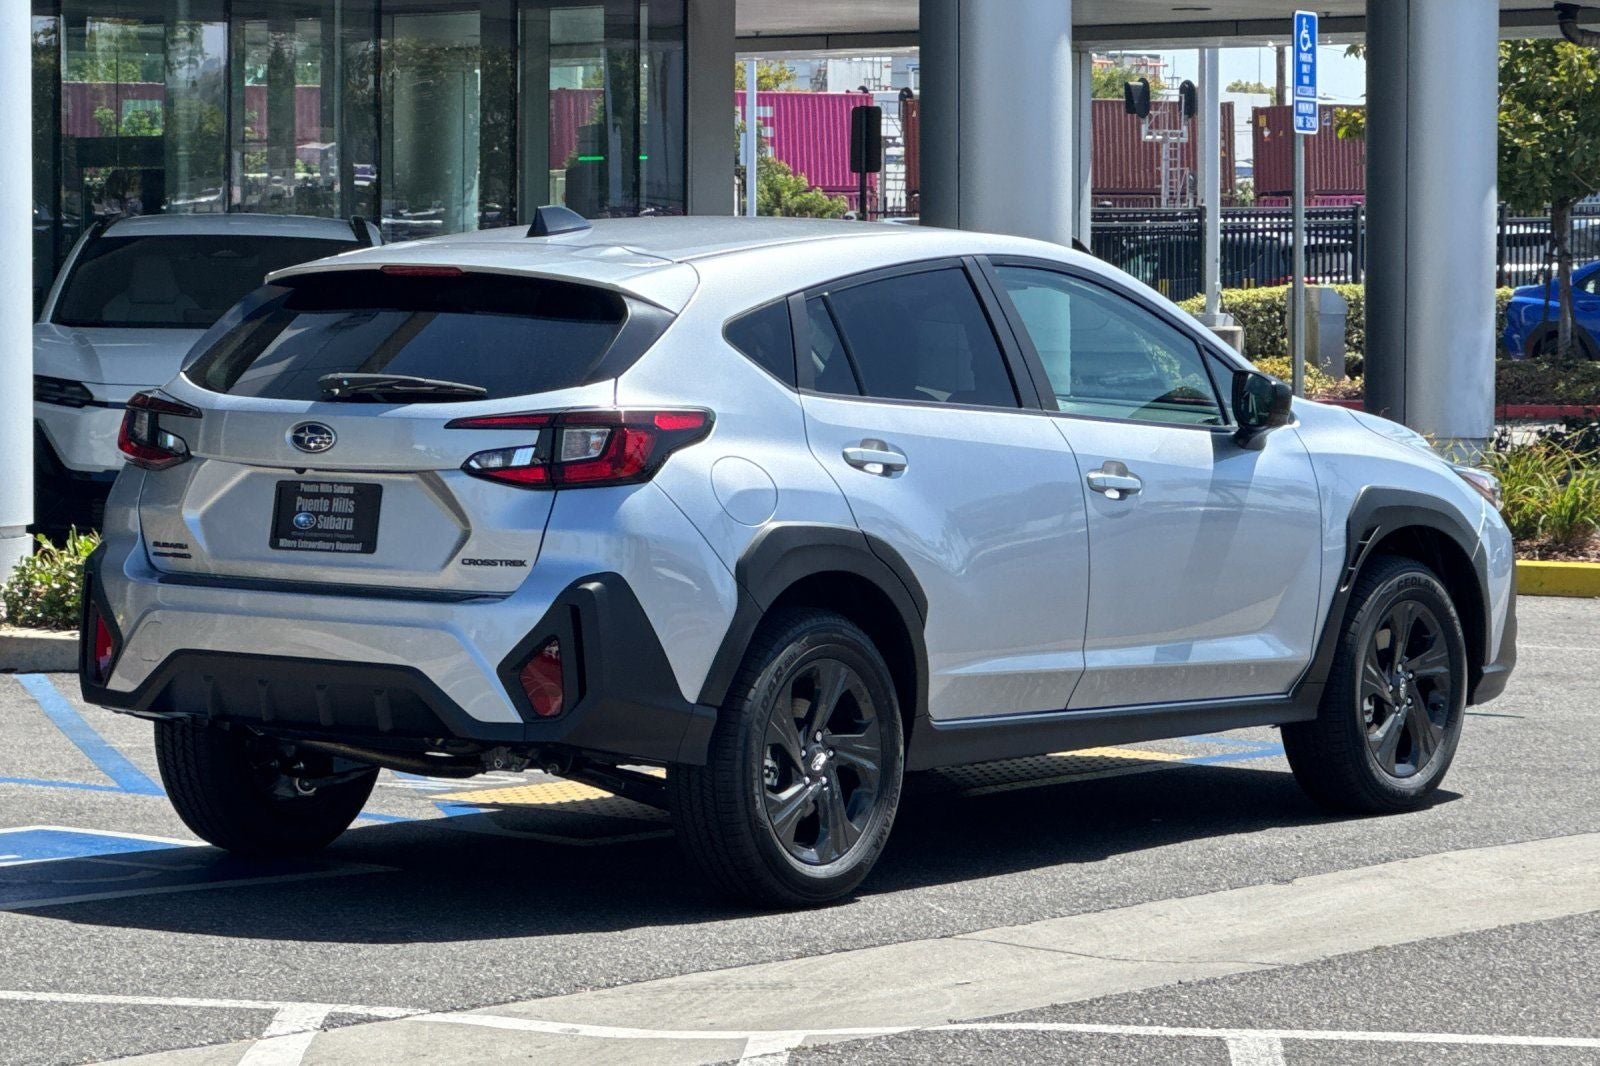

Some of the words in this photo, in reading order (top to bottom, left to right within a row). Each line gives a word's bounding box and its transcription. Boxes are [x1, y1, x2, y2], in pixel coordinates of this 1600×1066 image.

[333, 484, 354, 494] Subaru
[296, 496, 330, 512] Puente
[331, 497, 355, 513] Hills
[317, 514, 354, 531] Subaru
[461, 558, 527, 567] CROSSTREK
